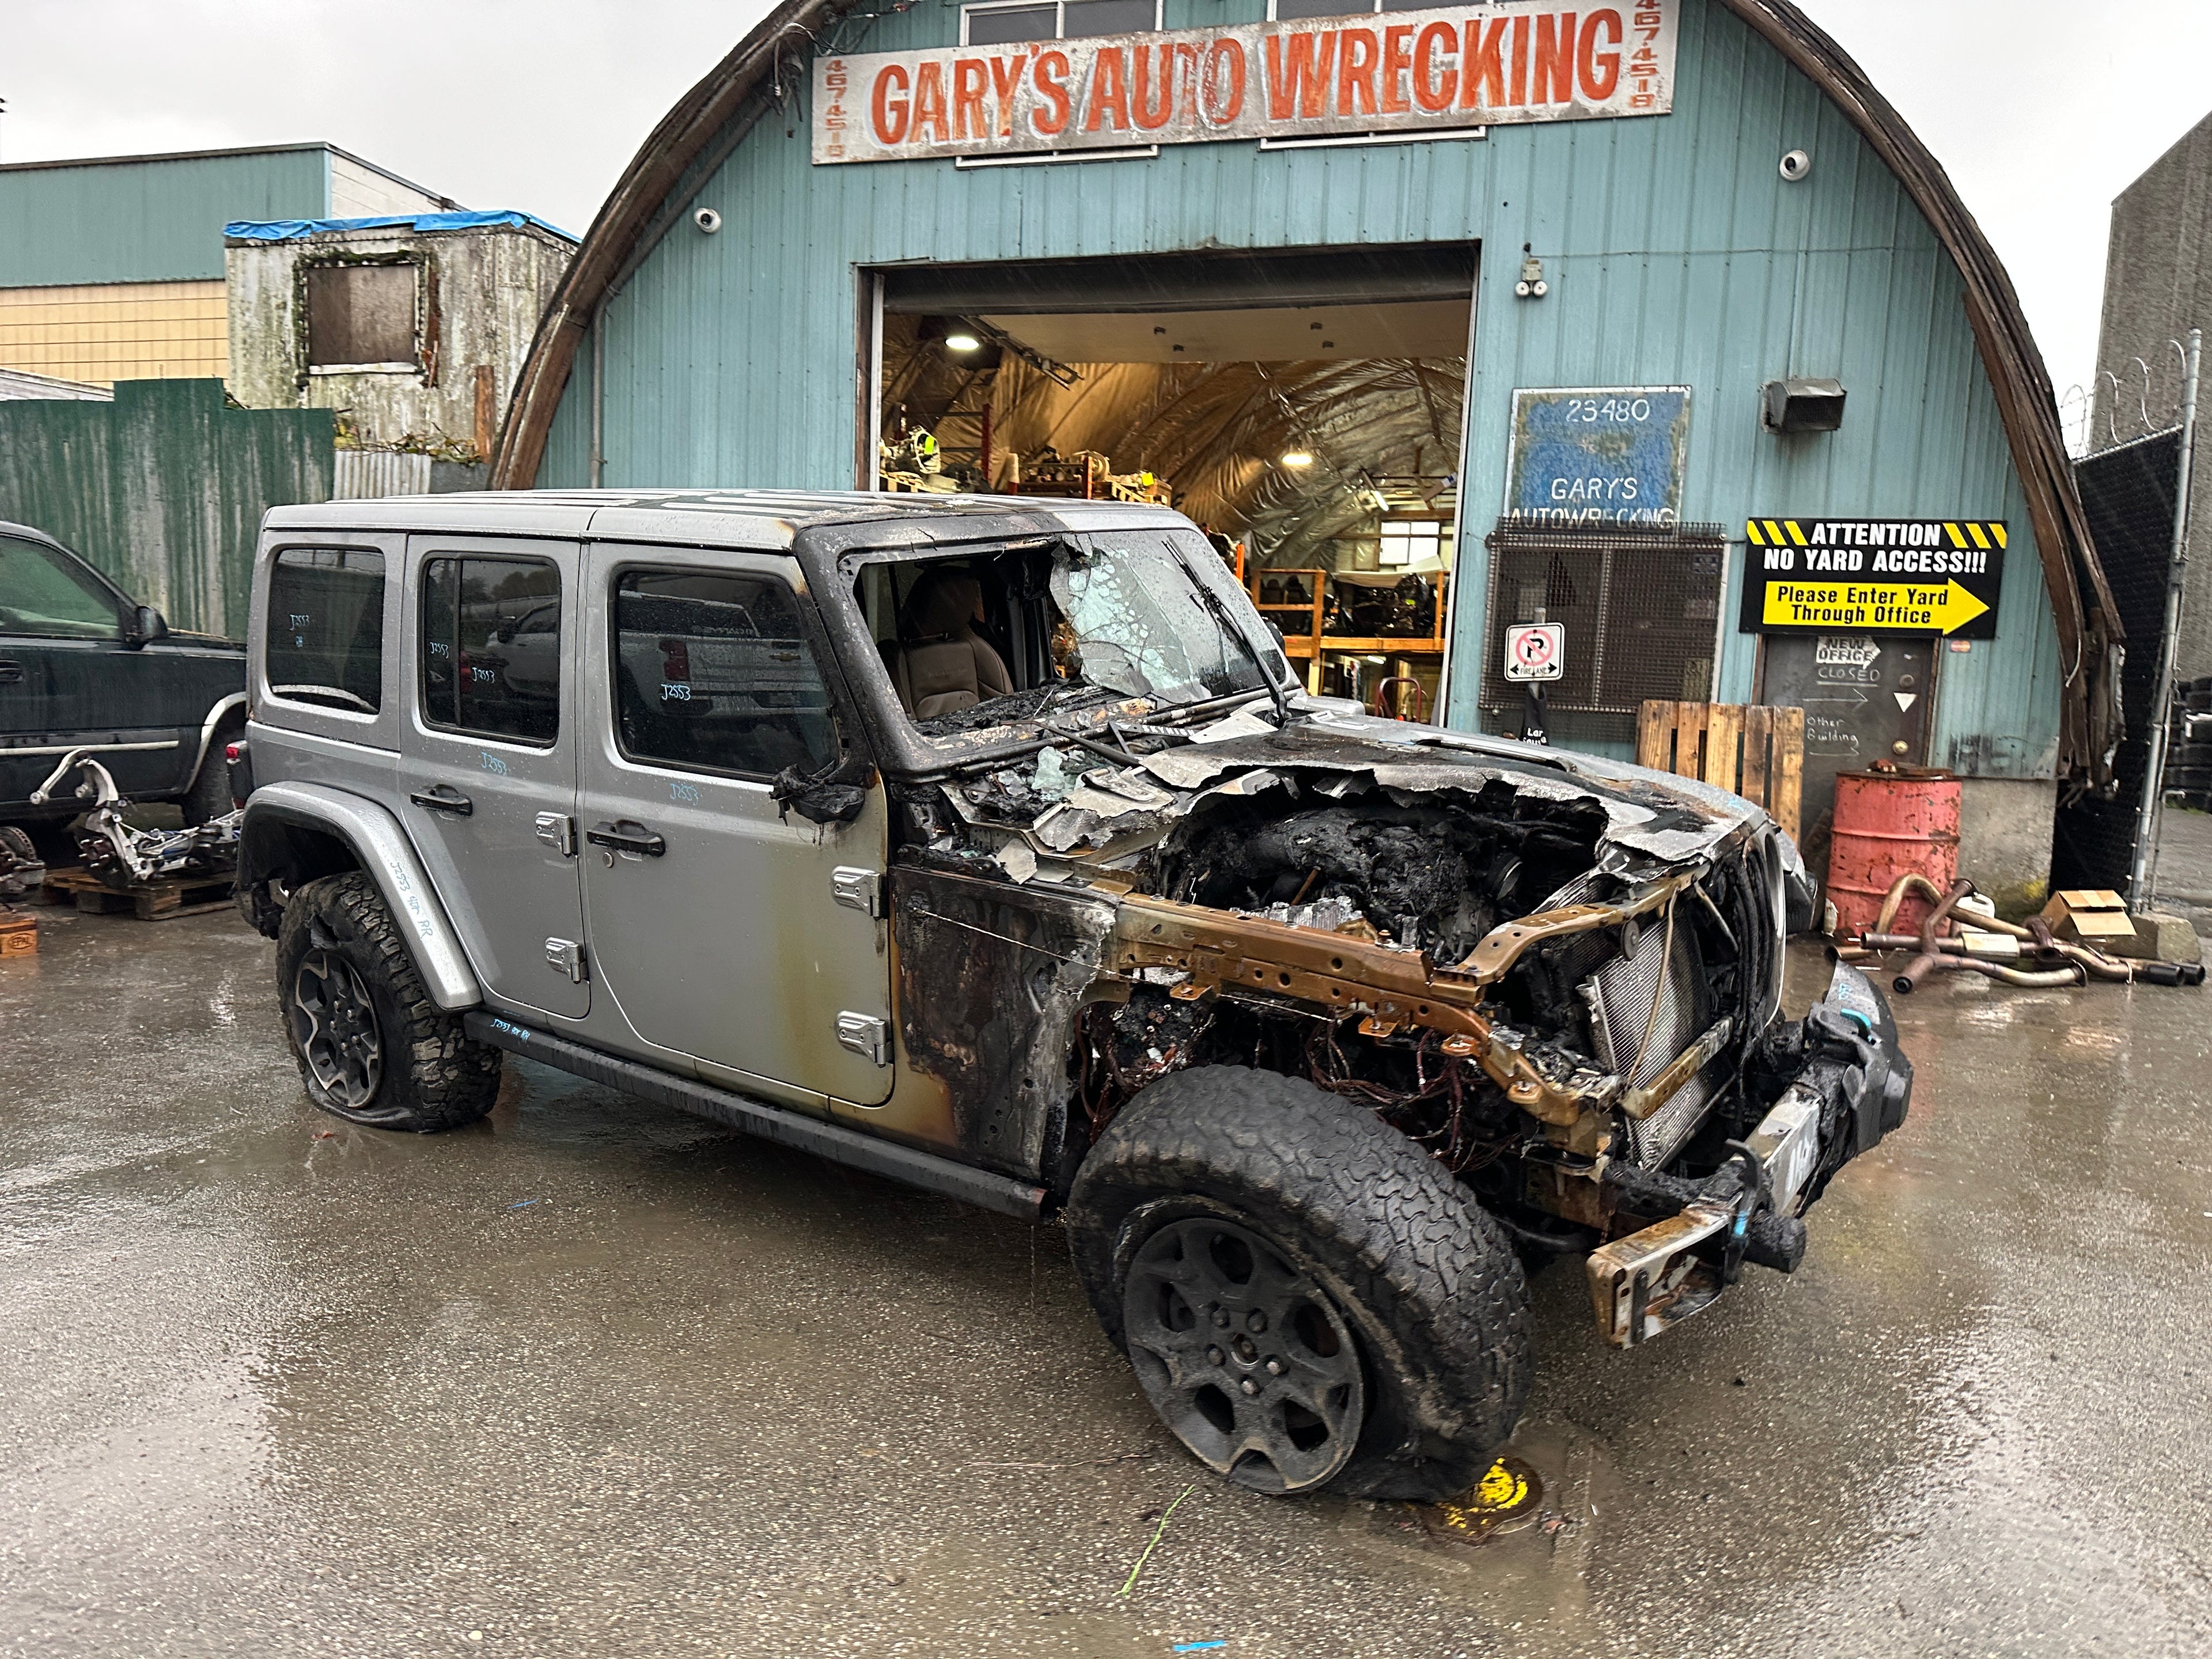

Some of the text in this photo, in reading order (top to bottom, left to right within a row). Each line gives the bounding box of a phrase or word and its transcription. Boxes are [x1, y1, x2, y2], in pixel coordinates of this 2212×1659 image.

[870, 8, 1623, 145] GARY'S AUTO WRECKING
[1566, 399, 1650, 422] 23480
[1551, 477, 1638, 500] GARY'S
[1811, 523, 1941, 546] ATTENTION
[1763, 548, 1987, 573] NO YARD ACCESS!!!
[1777, 586, 1949, 605] Please Enter Yard
[1791, 605, 1931, 624] Through Office
[1825, 638, 1865, 649] NEW
[661, 684, 691, 700] J2553
[1806, 716, 1846, 727] Other
[1807, 728, 1859, 748] Building
